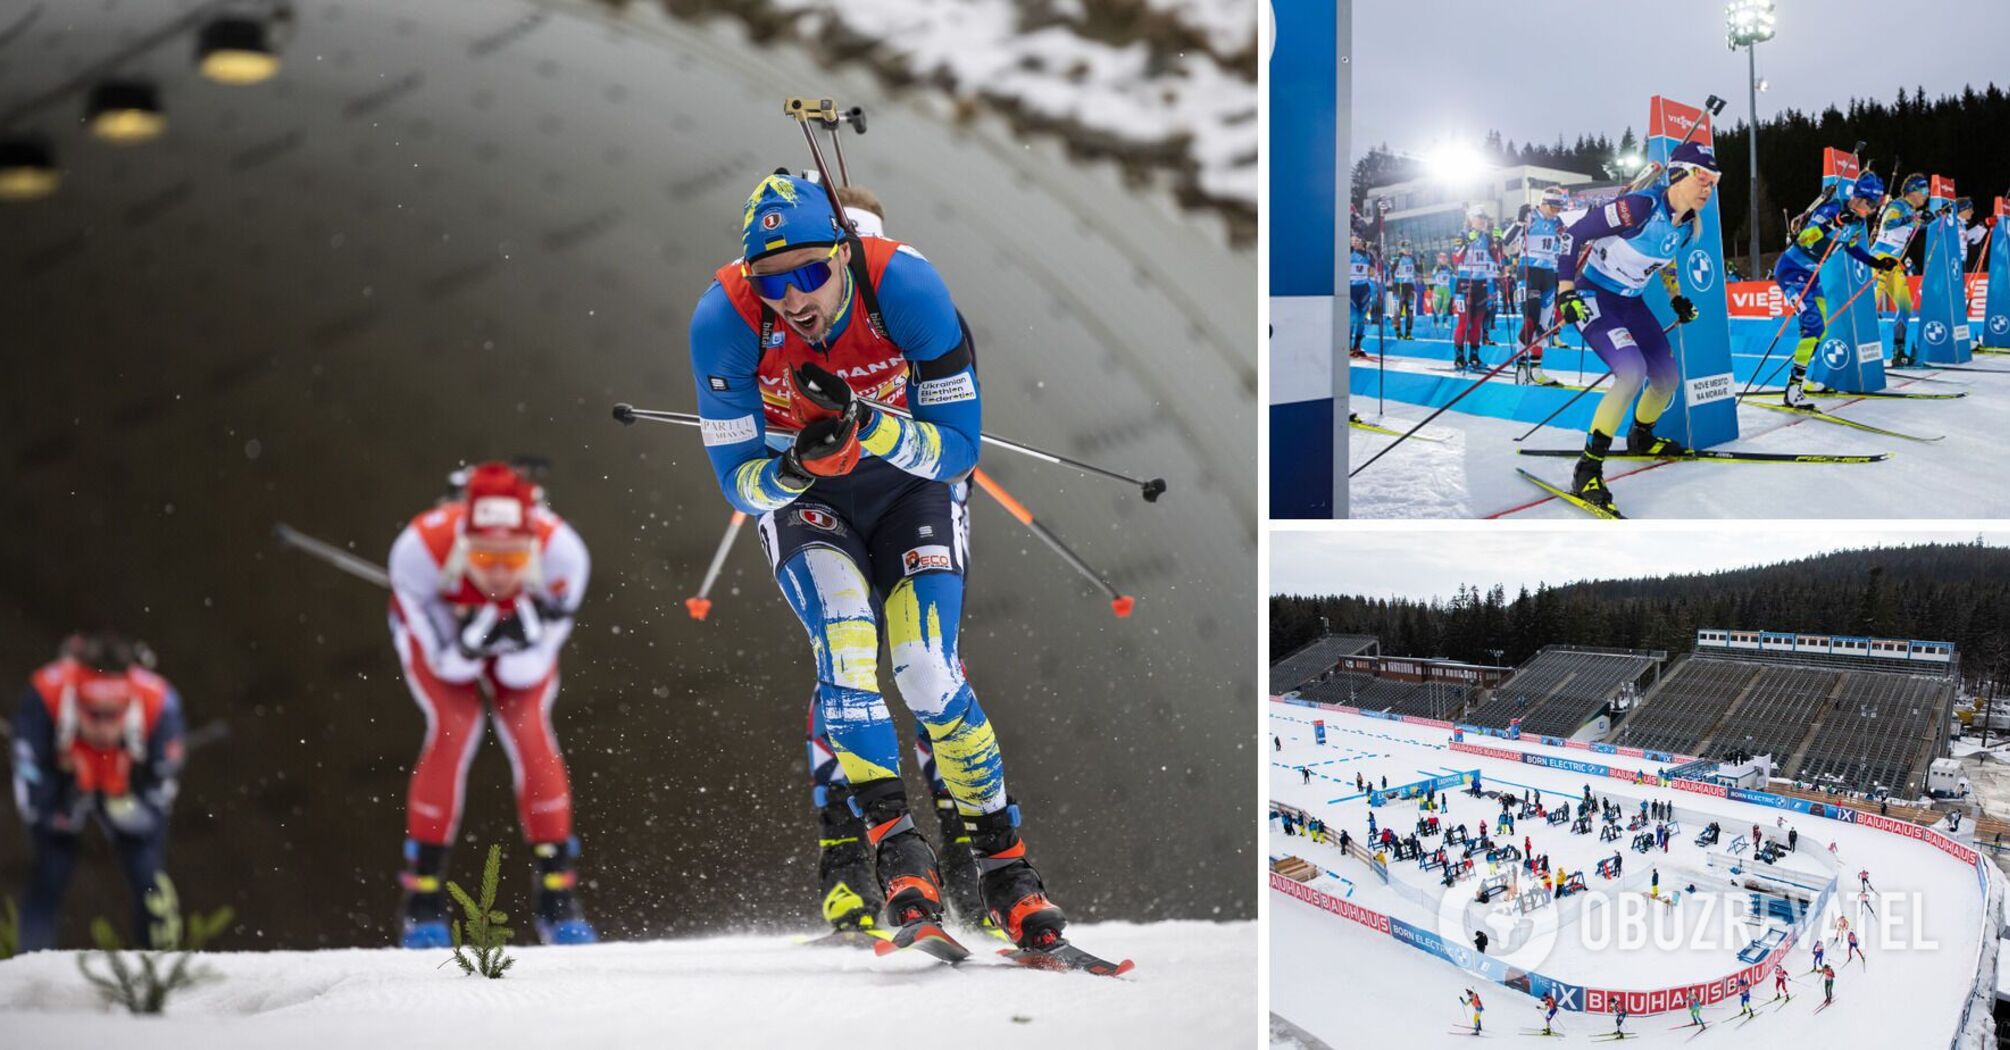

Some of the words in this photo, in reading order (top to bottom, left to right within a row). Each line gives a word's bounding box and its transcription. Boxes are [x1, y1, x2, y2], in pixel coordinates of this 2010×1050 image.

[921, 377, 967, 390] Ukrainian
[1527, 755, 1548, 766] BORN
[1550, 758, 1586, 772] ELECTRIC
[1610, 769, 1657, 785] BAUHUS
[1672, 779, 1726, 797] BAUHAUS
[1838, 808, 1852, 822] iX
[1857, 813, 1922, 838] BAUHAUS
[1925, 830, 1977, 864] BAUHAUS
[1270, 876, 1320, 905] AUHAUS
[1323, 895, 1389, 931] BAUHAUS
[1393, 925, 1414, 940] BORN
[1551, 982, 1578, 1009] iX
